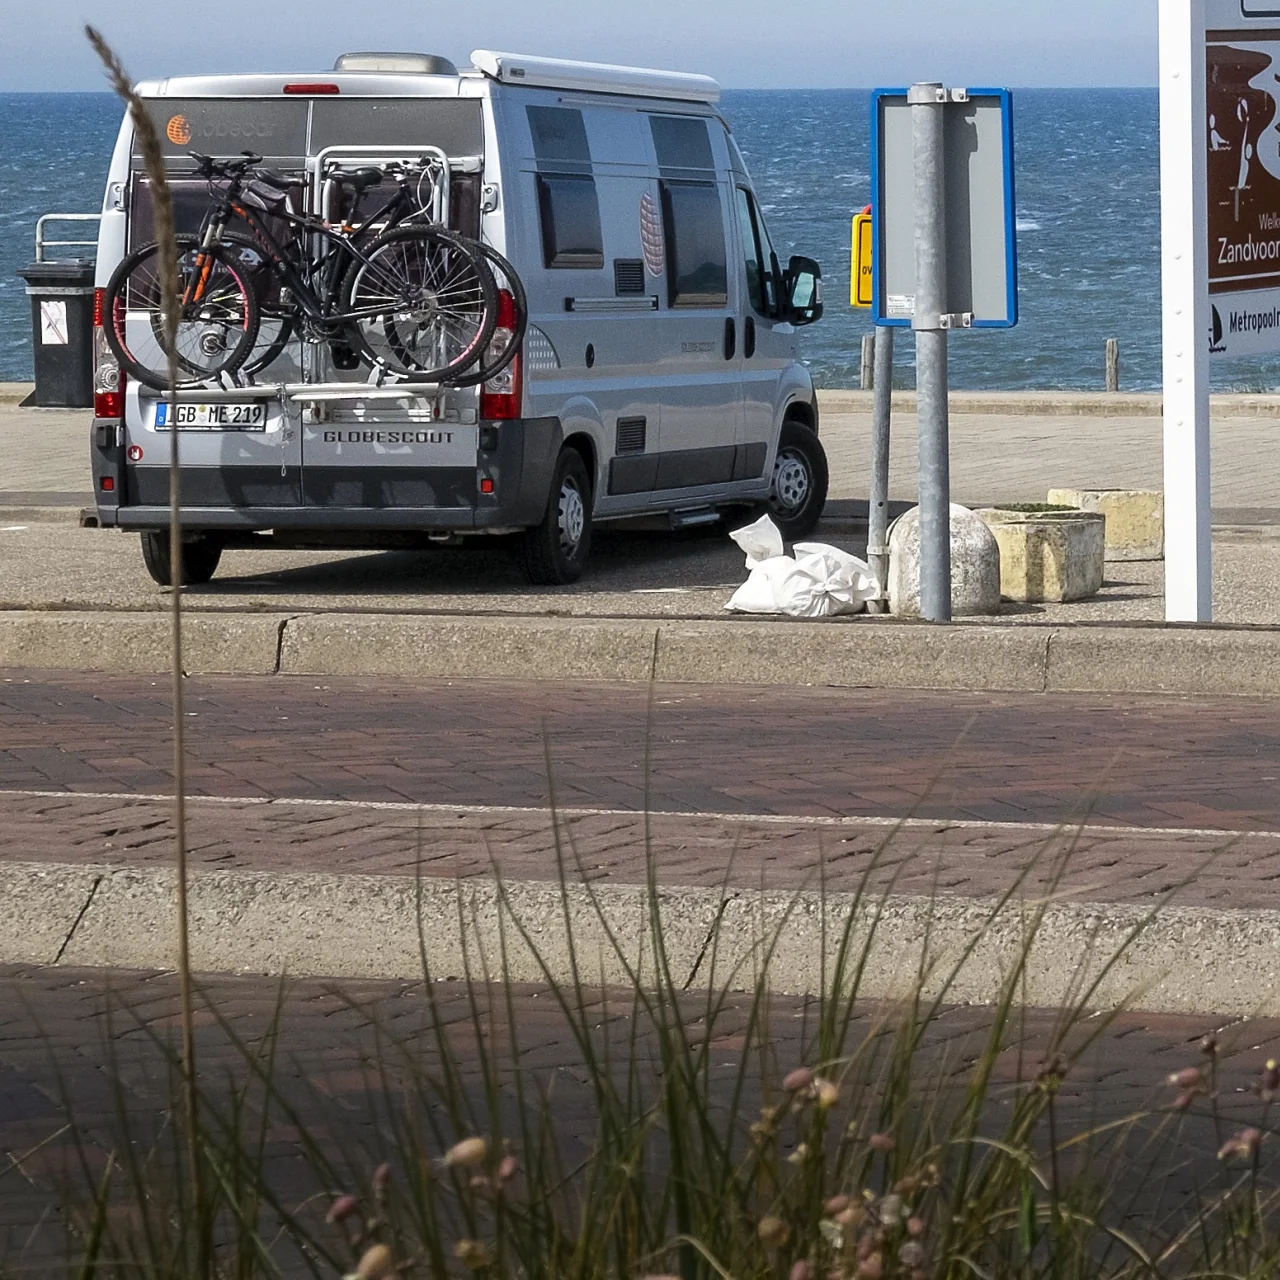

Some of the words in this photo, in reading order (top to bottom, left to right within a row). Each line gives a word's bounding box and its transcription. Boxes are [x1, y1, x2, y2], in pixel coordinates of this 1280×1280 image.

[208, 406, 228, 423] ME
[233, 406, 262, 423] 219
[323, 431, 455, 444] GLOBESCOUT
